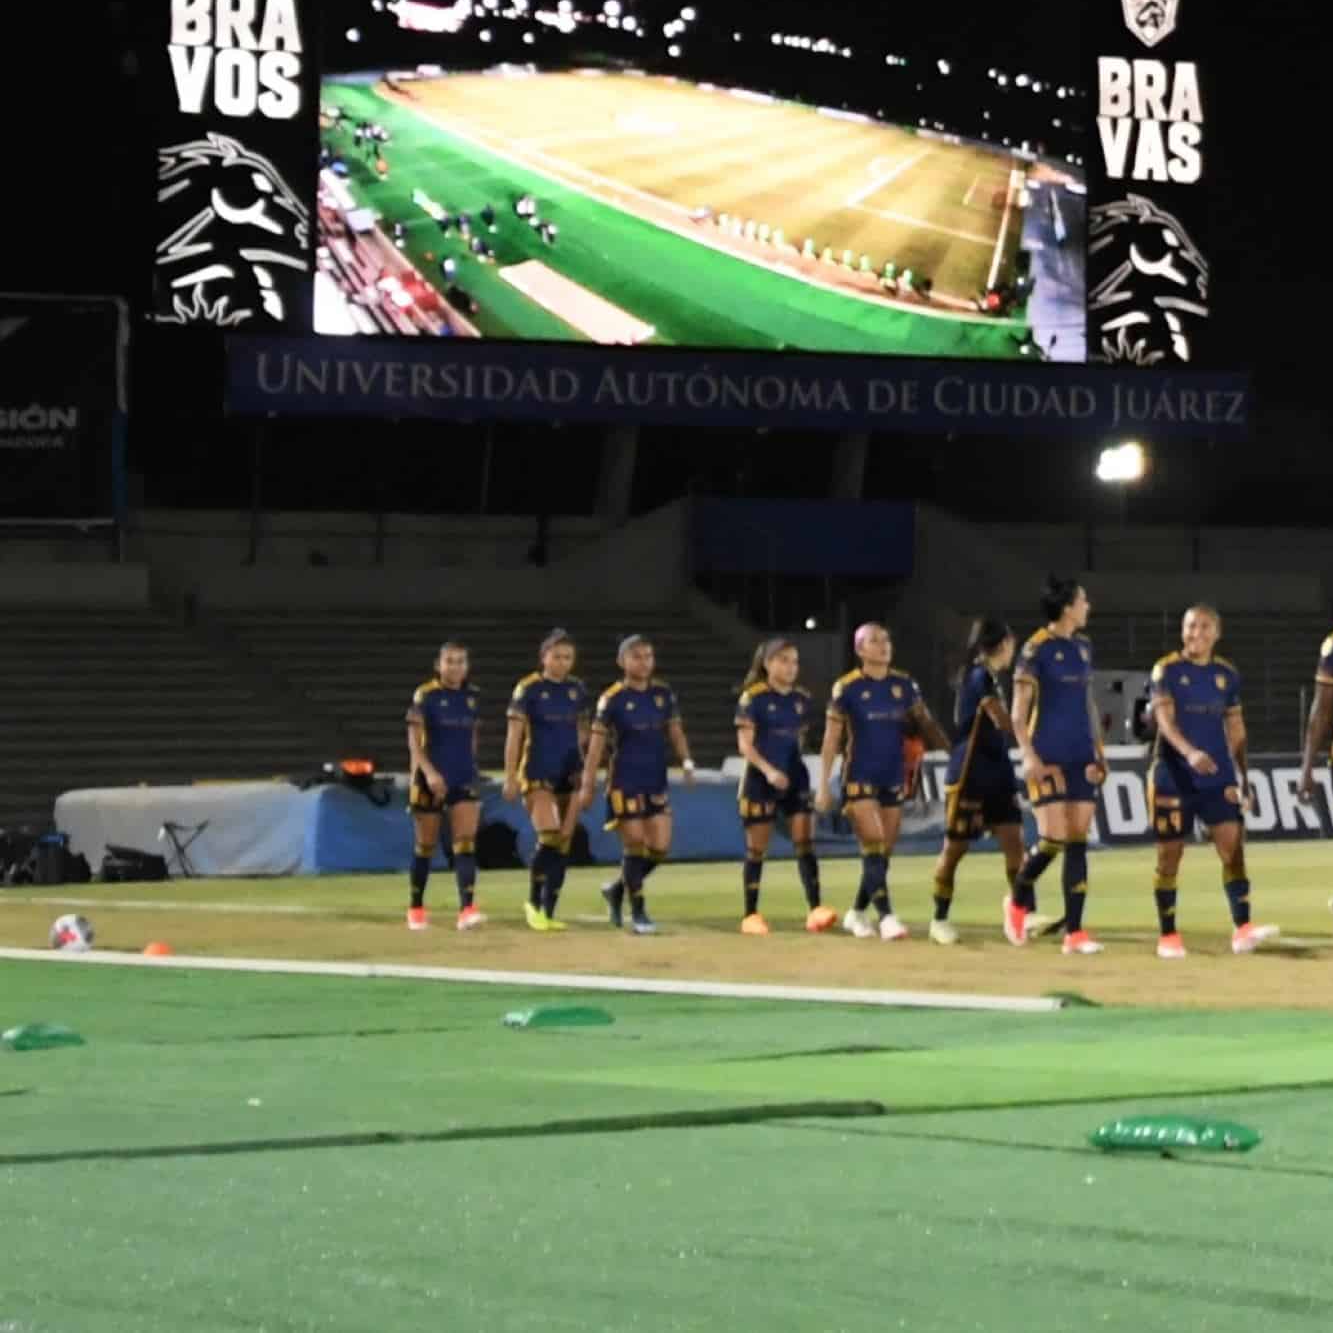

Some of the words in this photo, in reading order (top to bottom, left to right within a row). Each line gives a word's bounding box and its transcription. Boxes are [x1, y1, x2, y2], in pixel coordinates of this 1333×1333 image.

[168, 44, 301, 118] VOS
[1097, 56, 1203, 123] BRA
[1096, 116, 1202, 184] VAS
[256, 352, 580, 404] UNIVERSIDAD
[595, 363, 852, 412] AUTÓNOMA
[868, 377, 919, 415] DE
[933, 374, 1097, 419] CIUDAD
[1112, 378, 1246, 427] JUÁREZ
